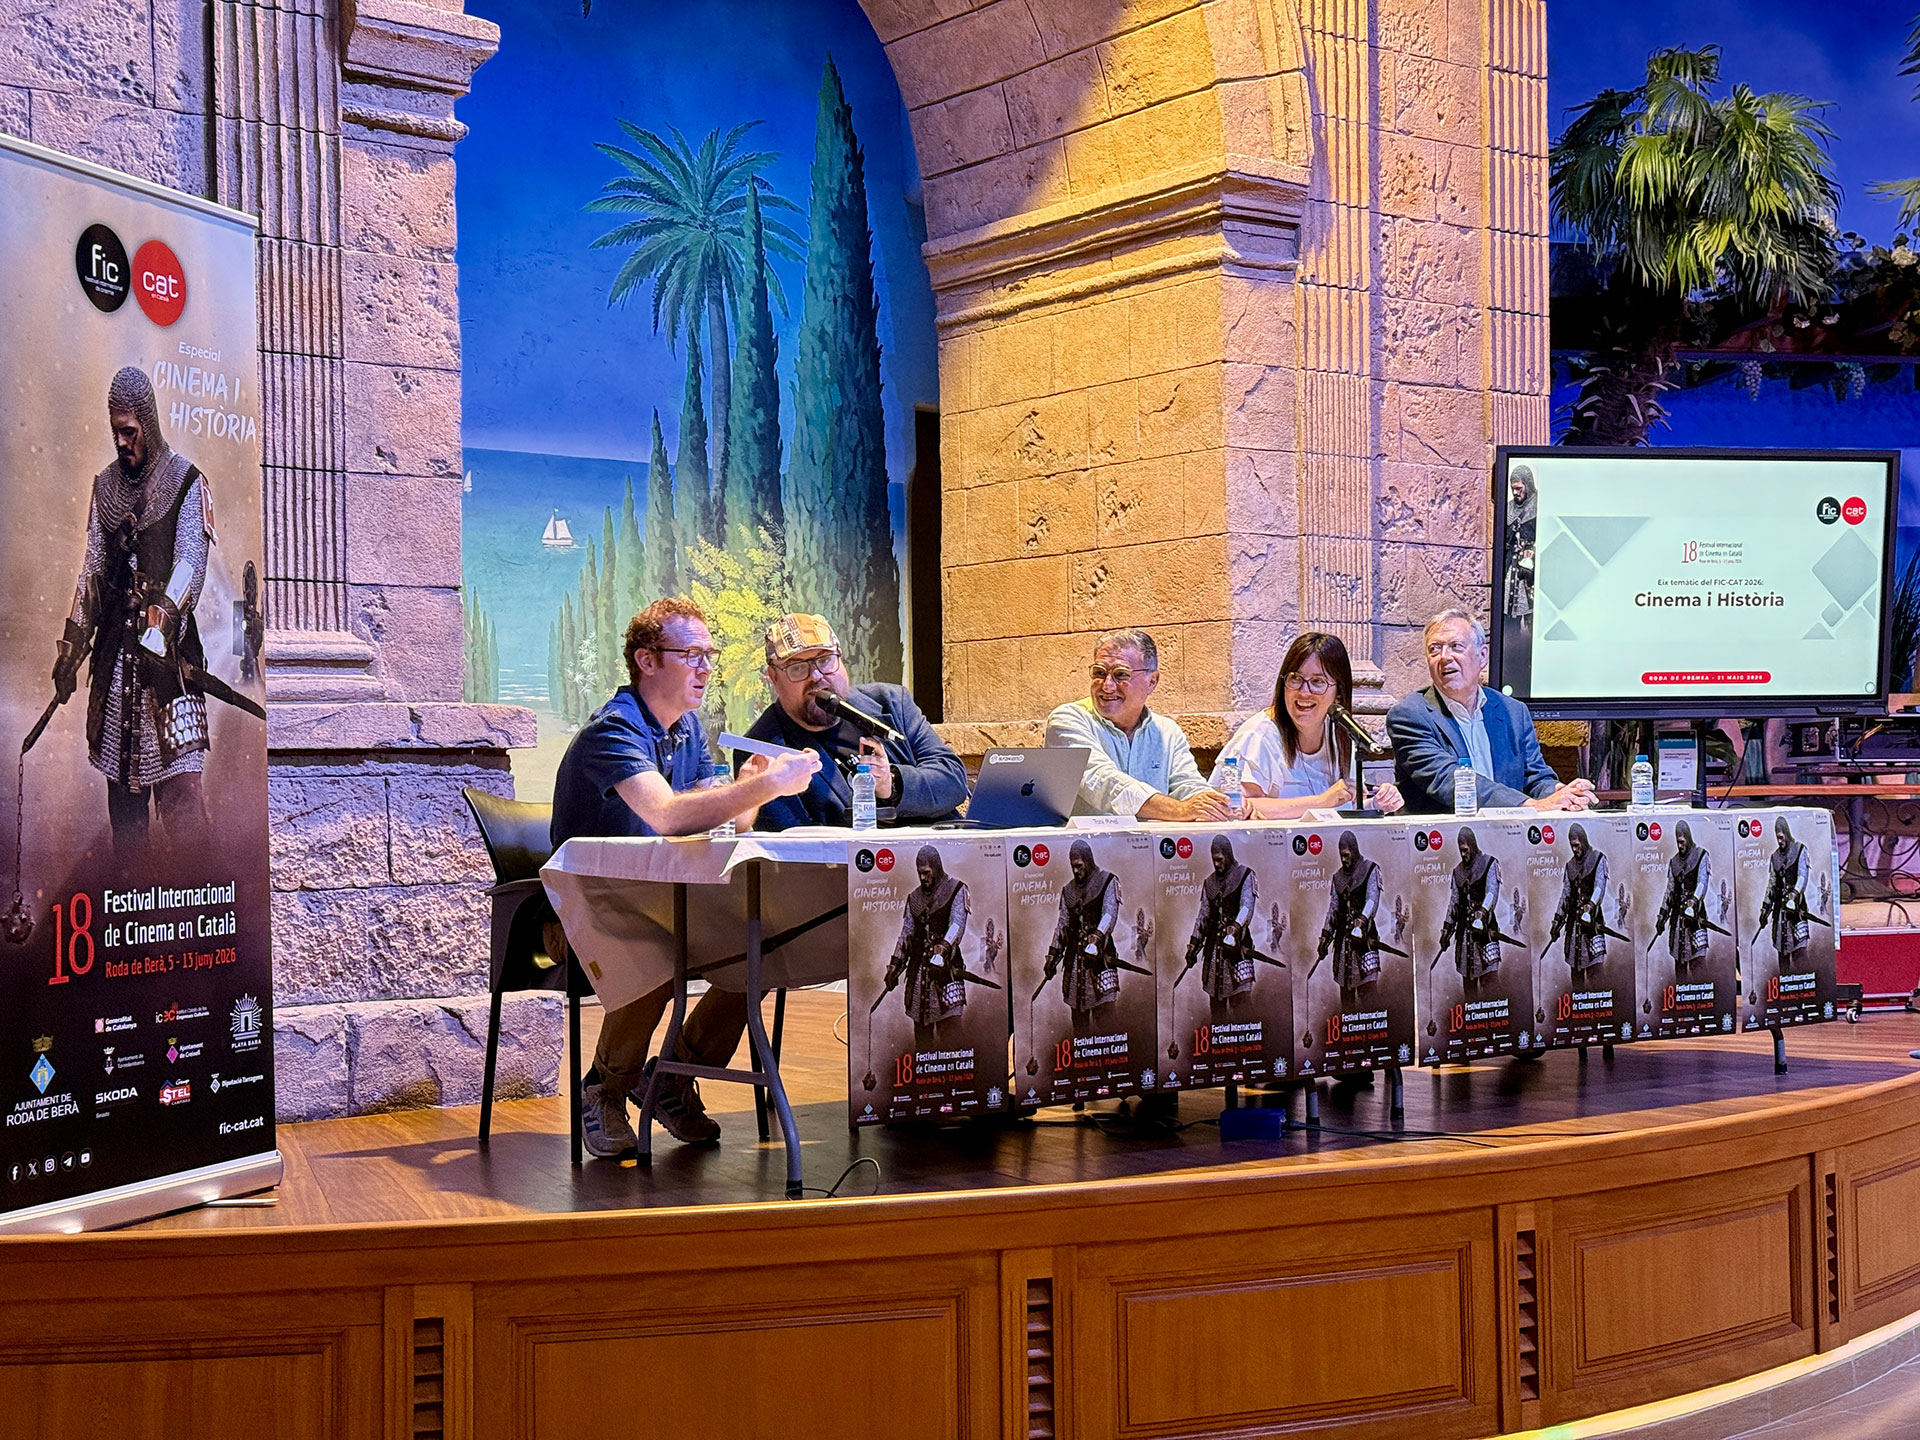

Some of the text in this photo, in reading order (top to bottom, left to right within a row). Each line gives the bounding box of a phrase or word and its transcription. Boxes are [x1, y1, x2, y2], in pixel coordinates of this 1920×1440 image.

[92, 244, 118, 282] fic
[143, 271, 179, 298] cat
[178, 341, 220, 362] Especial
[153, 360, 240, 406] CINEMA I
[170, 402, 256, 446] HISTÒRIA
[1823, 503, 1836, 515] fic
[1846, 507, 1864, 515] cat
[1682, 540, 1697, 564] 18
[1670, 578, 1699, 586] temàtic
[1700, 578, 1712, 586] del
[1635, 592, 1784, 607] Cinema i Història
[861, 854, 871, 864] fic
[879, 856, 893, 864] cat
[1159, 872, 1190, 883] CINEMA
[1292, 868, 1320, 879] CINEMA
[854, 887, 890, 898] CINEMA
[1013, 880, 1047, 893] CINEMA
[104, 881, 235, 914] Festival Internacional
[48, 892, 95, 985] 18
[104, 911, 236, 947] de Cinema en Català
[106, 961, 129, 978] Roda
[131, 959, 142, 975] de
[145, 955, 166, 974] Berà,
[168, 955, 174, 970] 5
[183, 953, 193, 968] 13
[194, 951, 213, 970] juny
[216, 947, 236, 964] 2026
[1662, 985, 1674, 1011] 18
[1767, 977, 1778, 1002] 18
[1557, 994, 1570, 1020] 18
[112, 1022, 137, 1031] Catalunya
[1449, 1004, 1463, 1032] 18
[1212, 1024, 1230, 1033] Festival
[1326, 1015, 1340, 1044] 18
[1074, 1032, 1127, 1046] Festival Internacional
[1193, 1026, 1209, 1056] 18
[916, 1048, 974, 1061] Festival Internacional
[1054, 1039, 1071, 1071] 18
[1082, 1048, 1102, 1057] Cinema
[1111, 1043, 1128, 1054] Català
[893, 1054, 913, 1087] 18
[924, 1063, 946, 1073] Cinema
[956, 1059, 974, 1070] Català
[14, 1093, 72, 1112] AJUNTAMENT DE
[96, 1087, 138, 1104] SKODA
[160, 1088, 190, 1102] STEL
[7, 1111, 35, 1126] RODA
[36, 1108, 49, 1120] DE
[51, 1100, 79, 1118] BERÀ
[219, 1116, 264, 1135] fic-cat.cat
